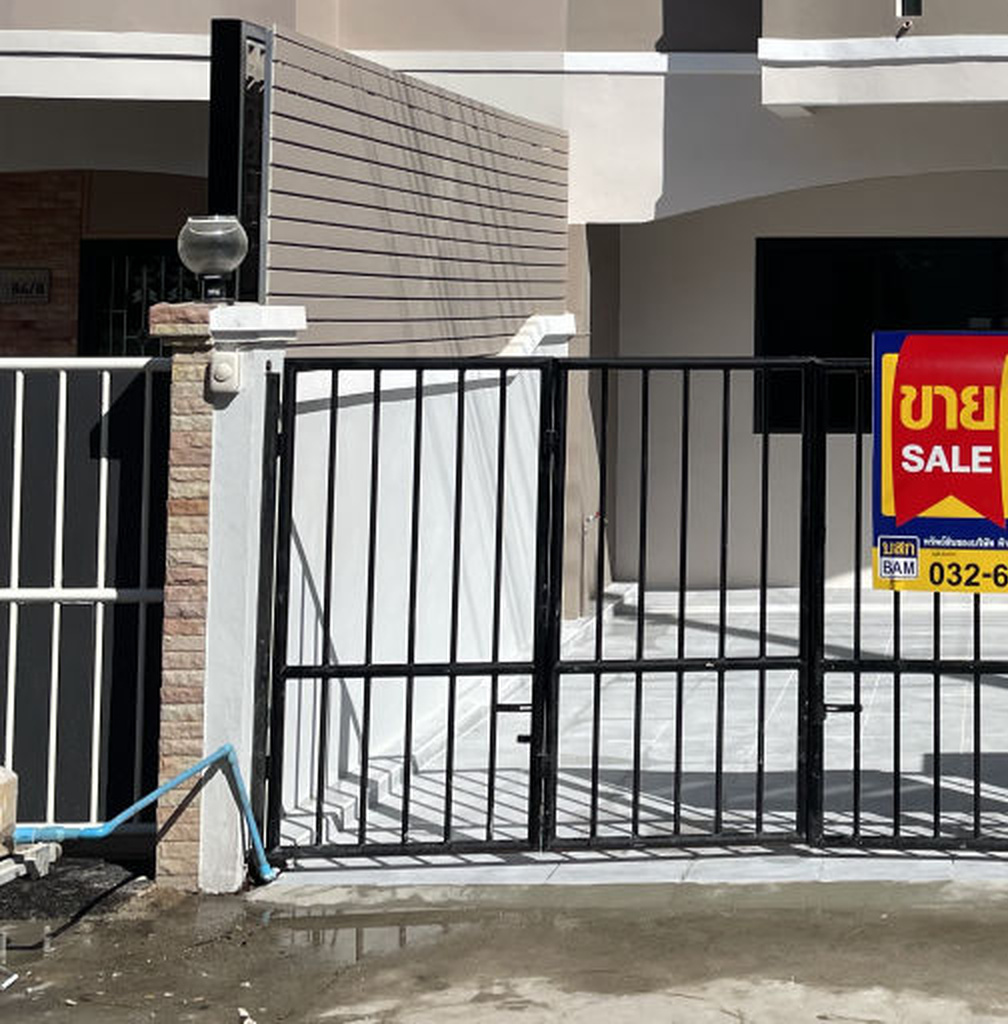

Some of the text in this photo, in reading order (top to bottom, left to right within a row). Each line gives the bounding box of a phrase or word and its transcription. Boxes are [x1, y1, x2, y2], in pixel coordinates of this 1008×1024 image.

[900, 385, 996, 431] ขาย
[901, 444, 993, 473] SALE
[883, 558, 915, 575] BAM
